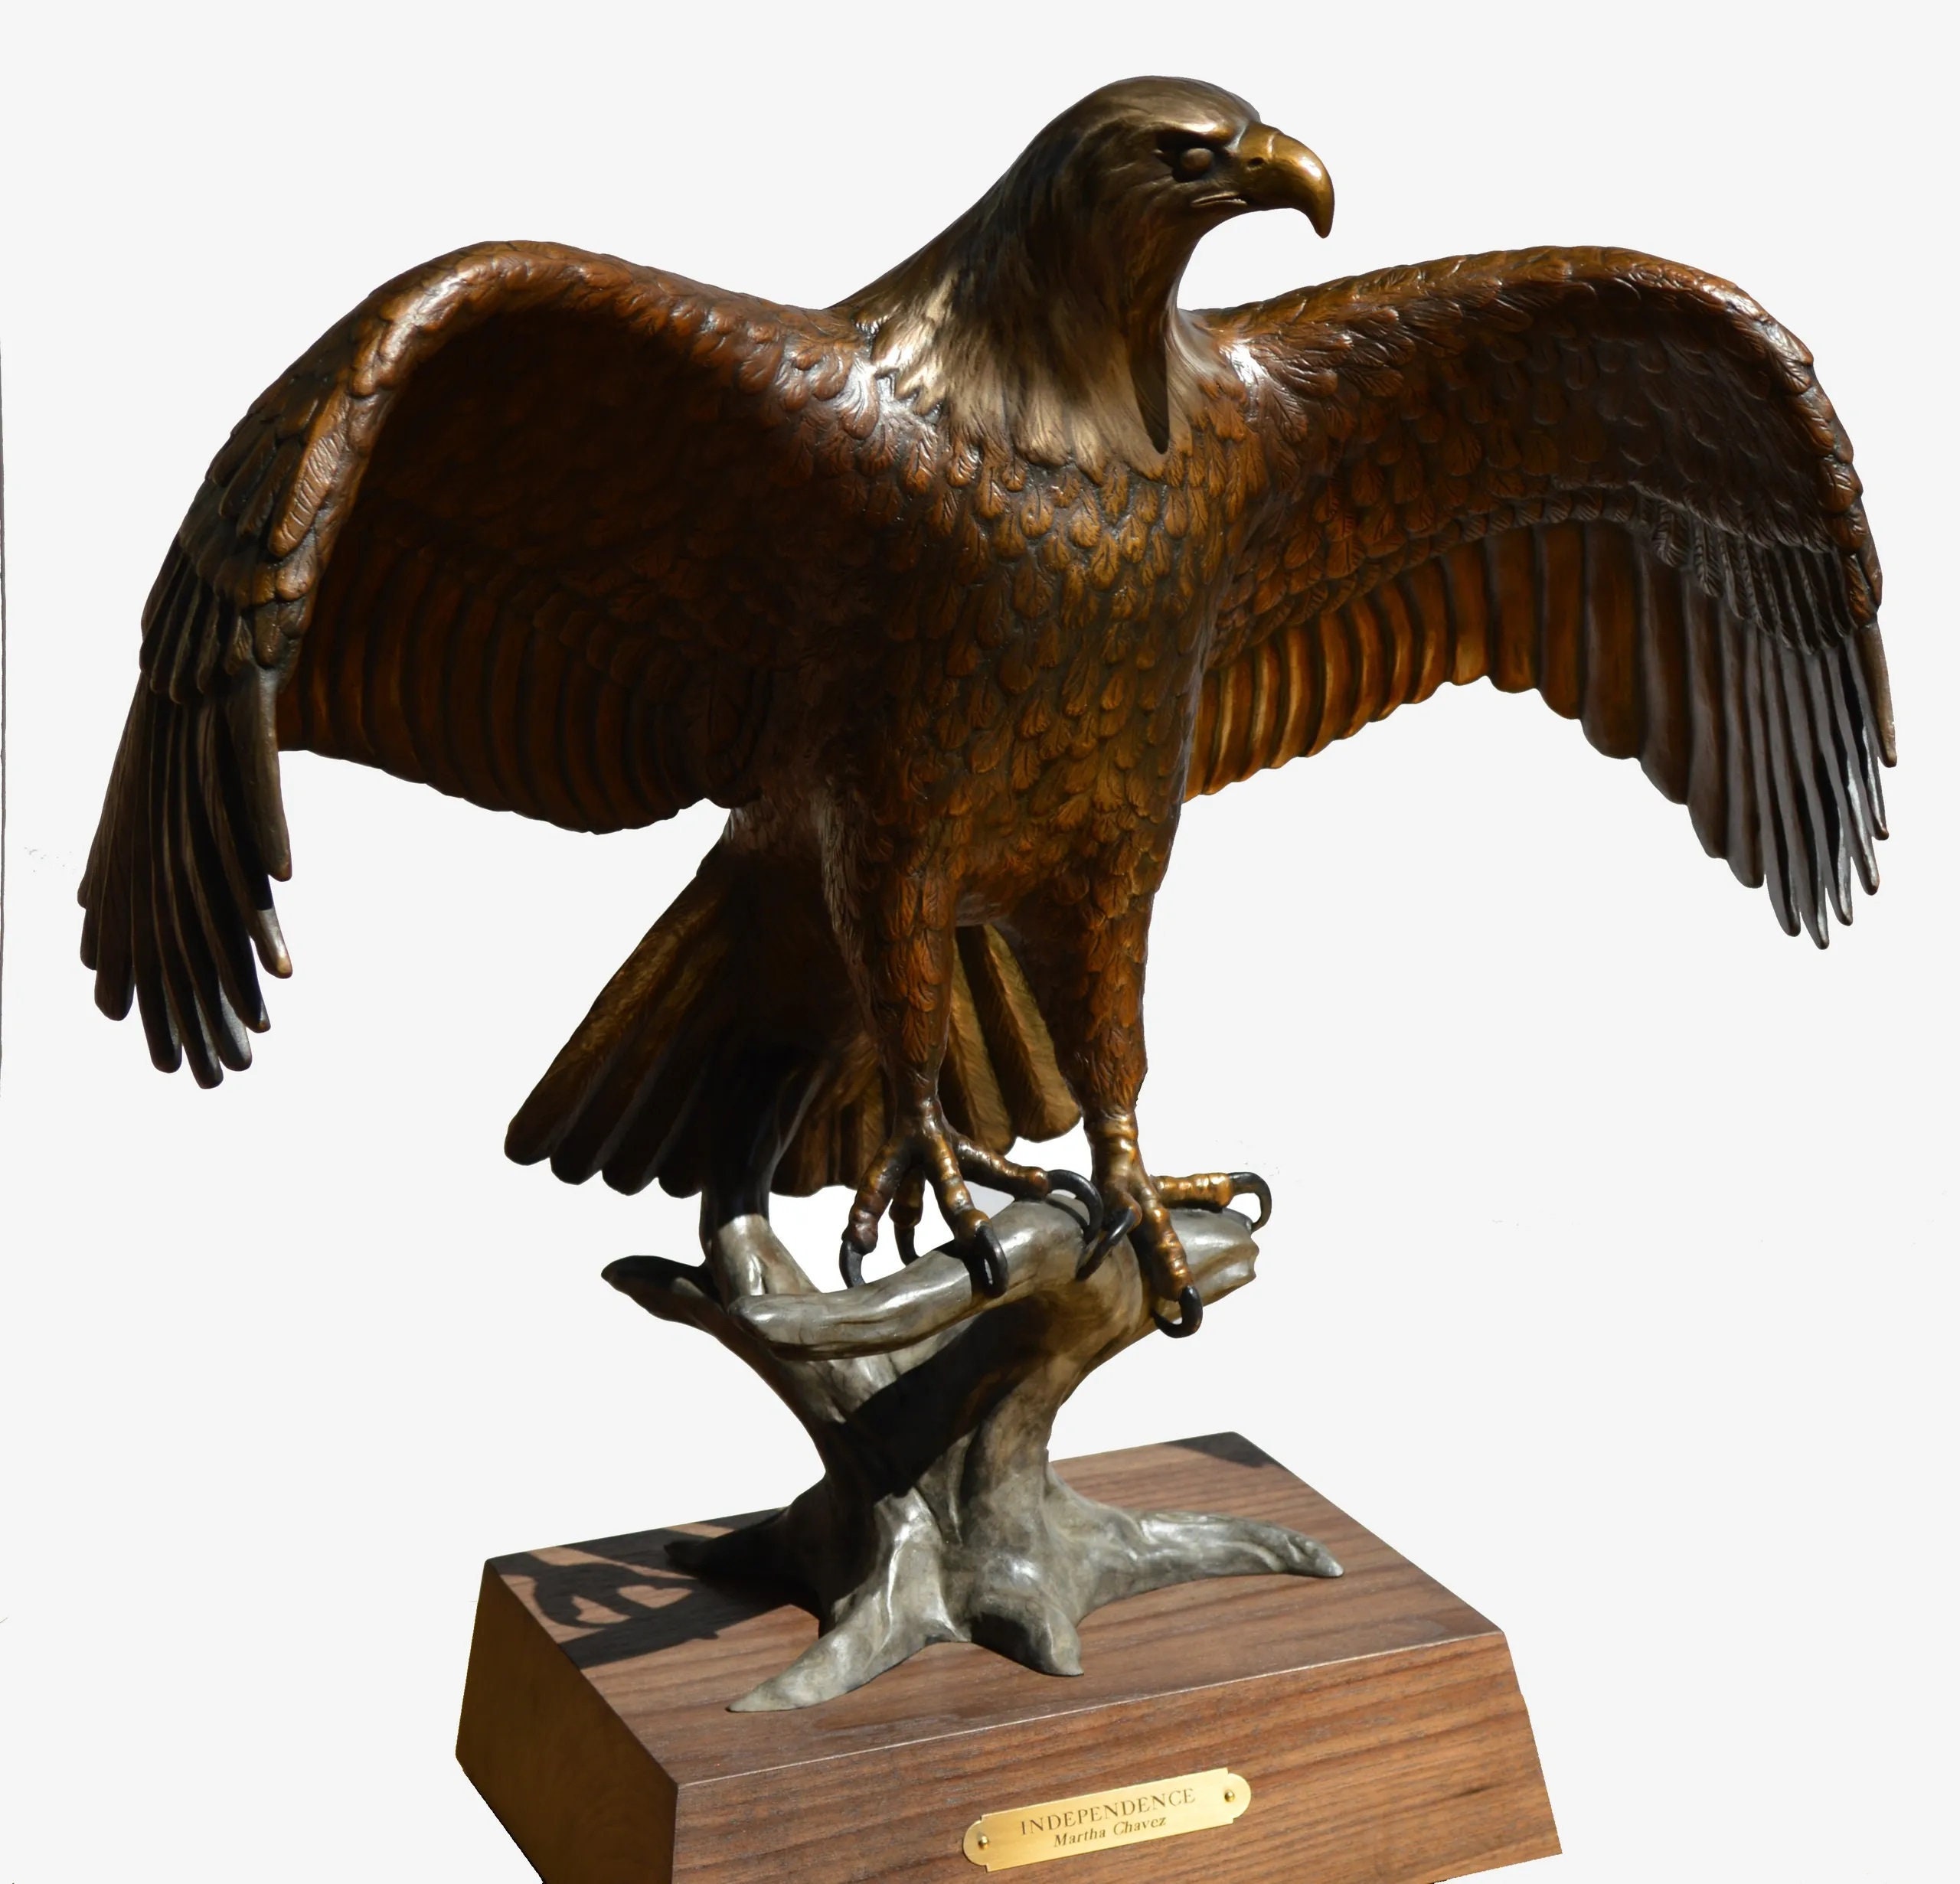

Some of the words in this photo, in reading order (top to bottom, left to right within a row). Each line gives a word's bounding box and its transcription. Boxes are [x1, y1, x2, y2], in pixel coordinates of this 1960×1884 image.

[1021, 1788, 1195, 1835] INDEPENDENCE
[1054, 1828, 1106, 1847] Martha
[1113, 1817, 1166, 1836] Chavez
